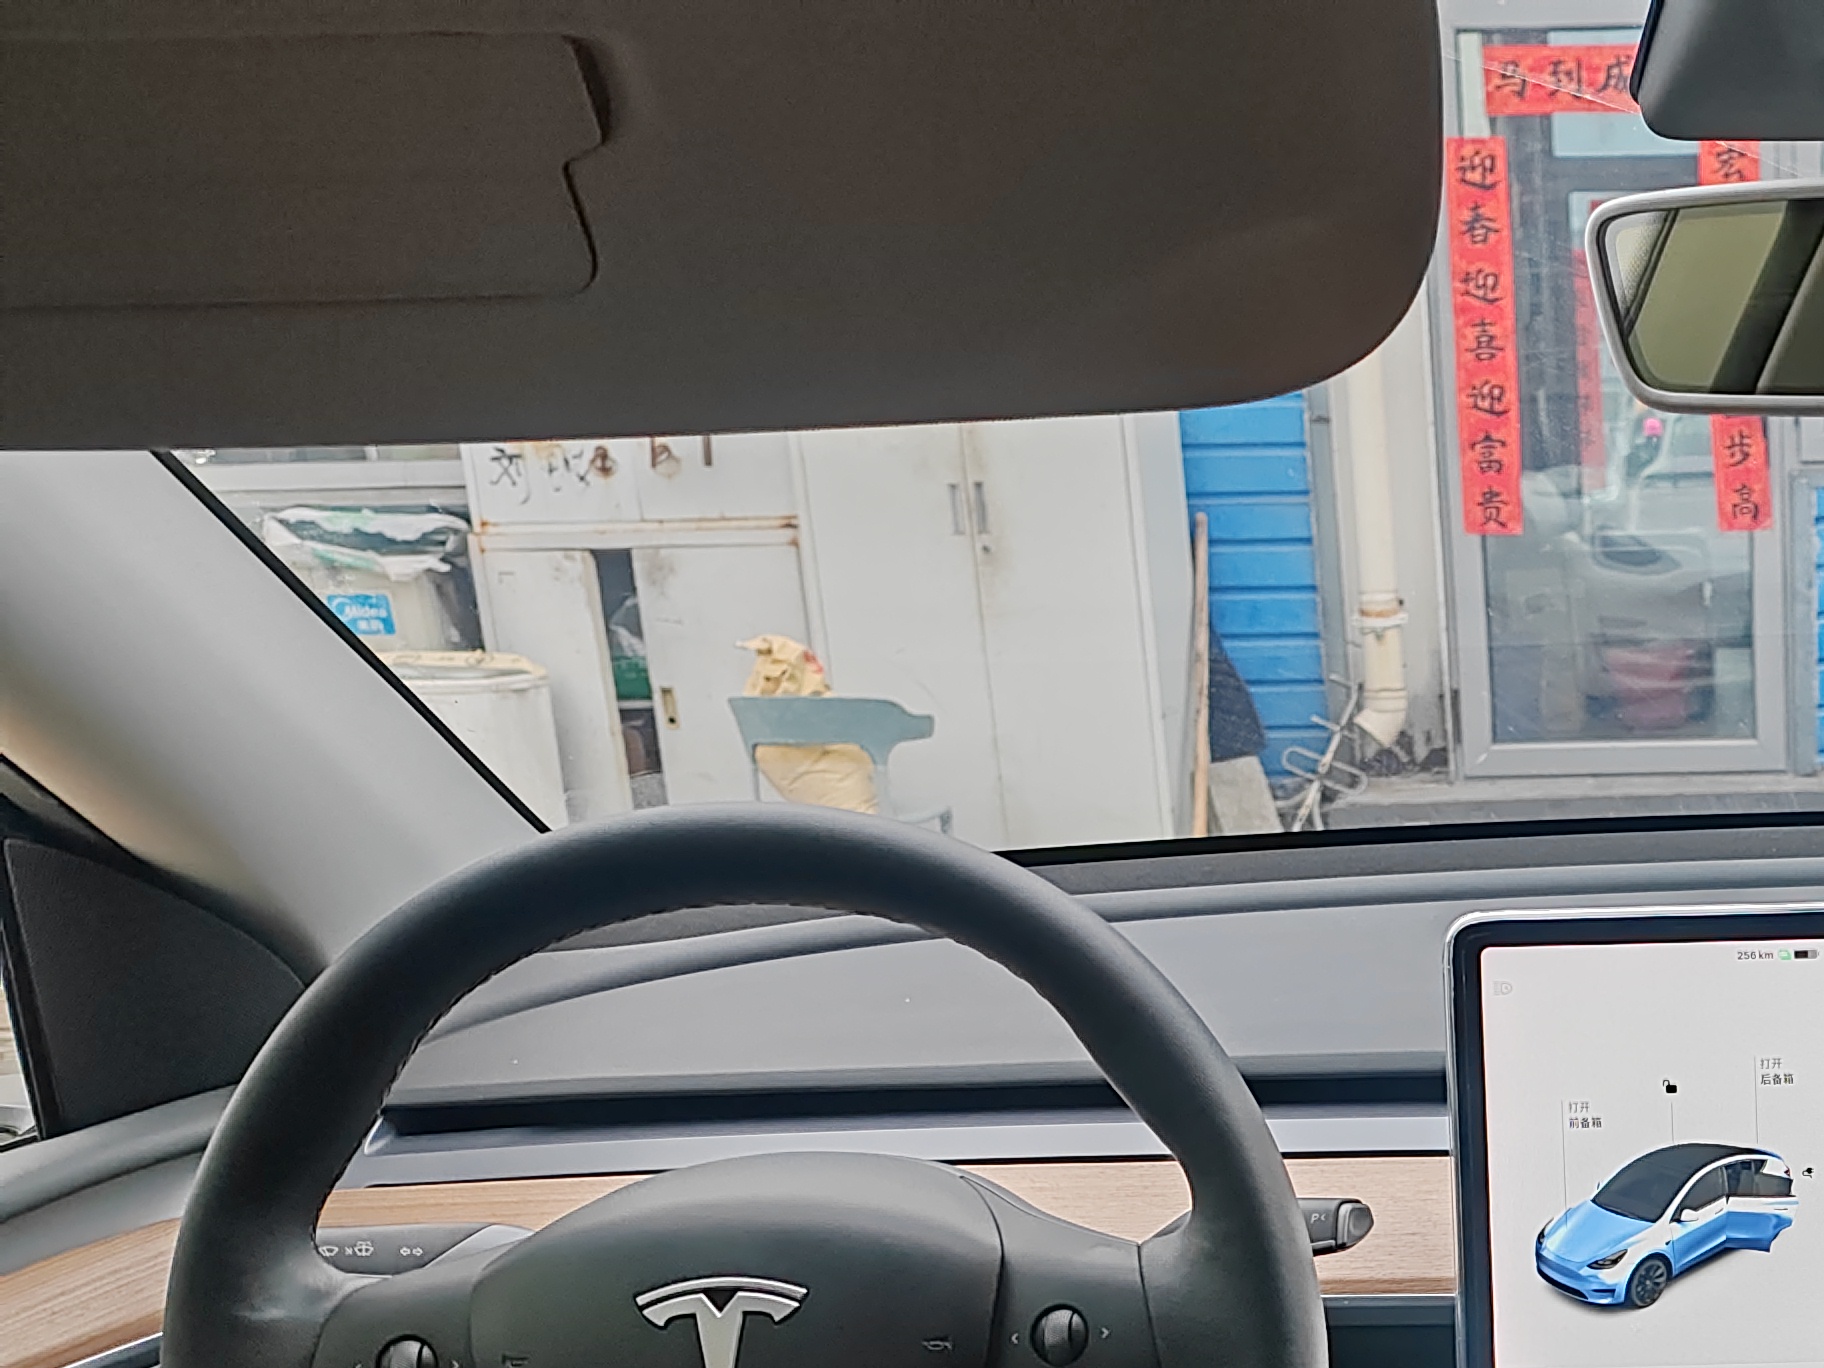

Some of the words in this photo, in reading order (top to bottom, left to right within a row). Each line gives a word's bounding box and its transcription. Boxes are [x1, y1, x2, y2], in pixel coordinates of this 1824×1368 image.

[1456, 149, 1511, 530] 迎春迎喜迎富贵
[1737, 951, 1757, 961] 256
[1758, 950, 1774, 959] km
[1760, 1058, 1783, 1069] 打开
[1760, 1073, 1794, 1085] 后备箱
[1569, 1101, 1590, 1113] 打开
[1569, 1117, 1602, 1128] 前备箱
